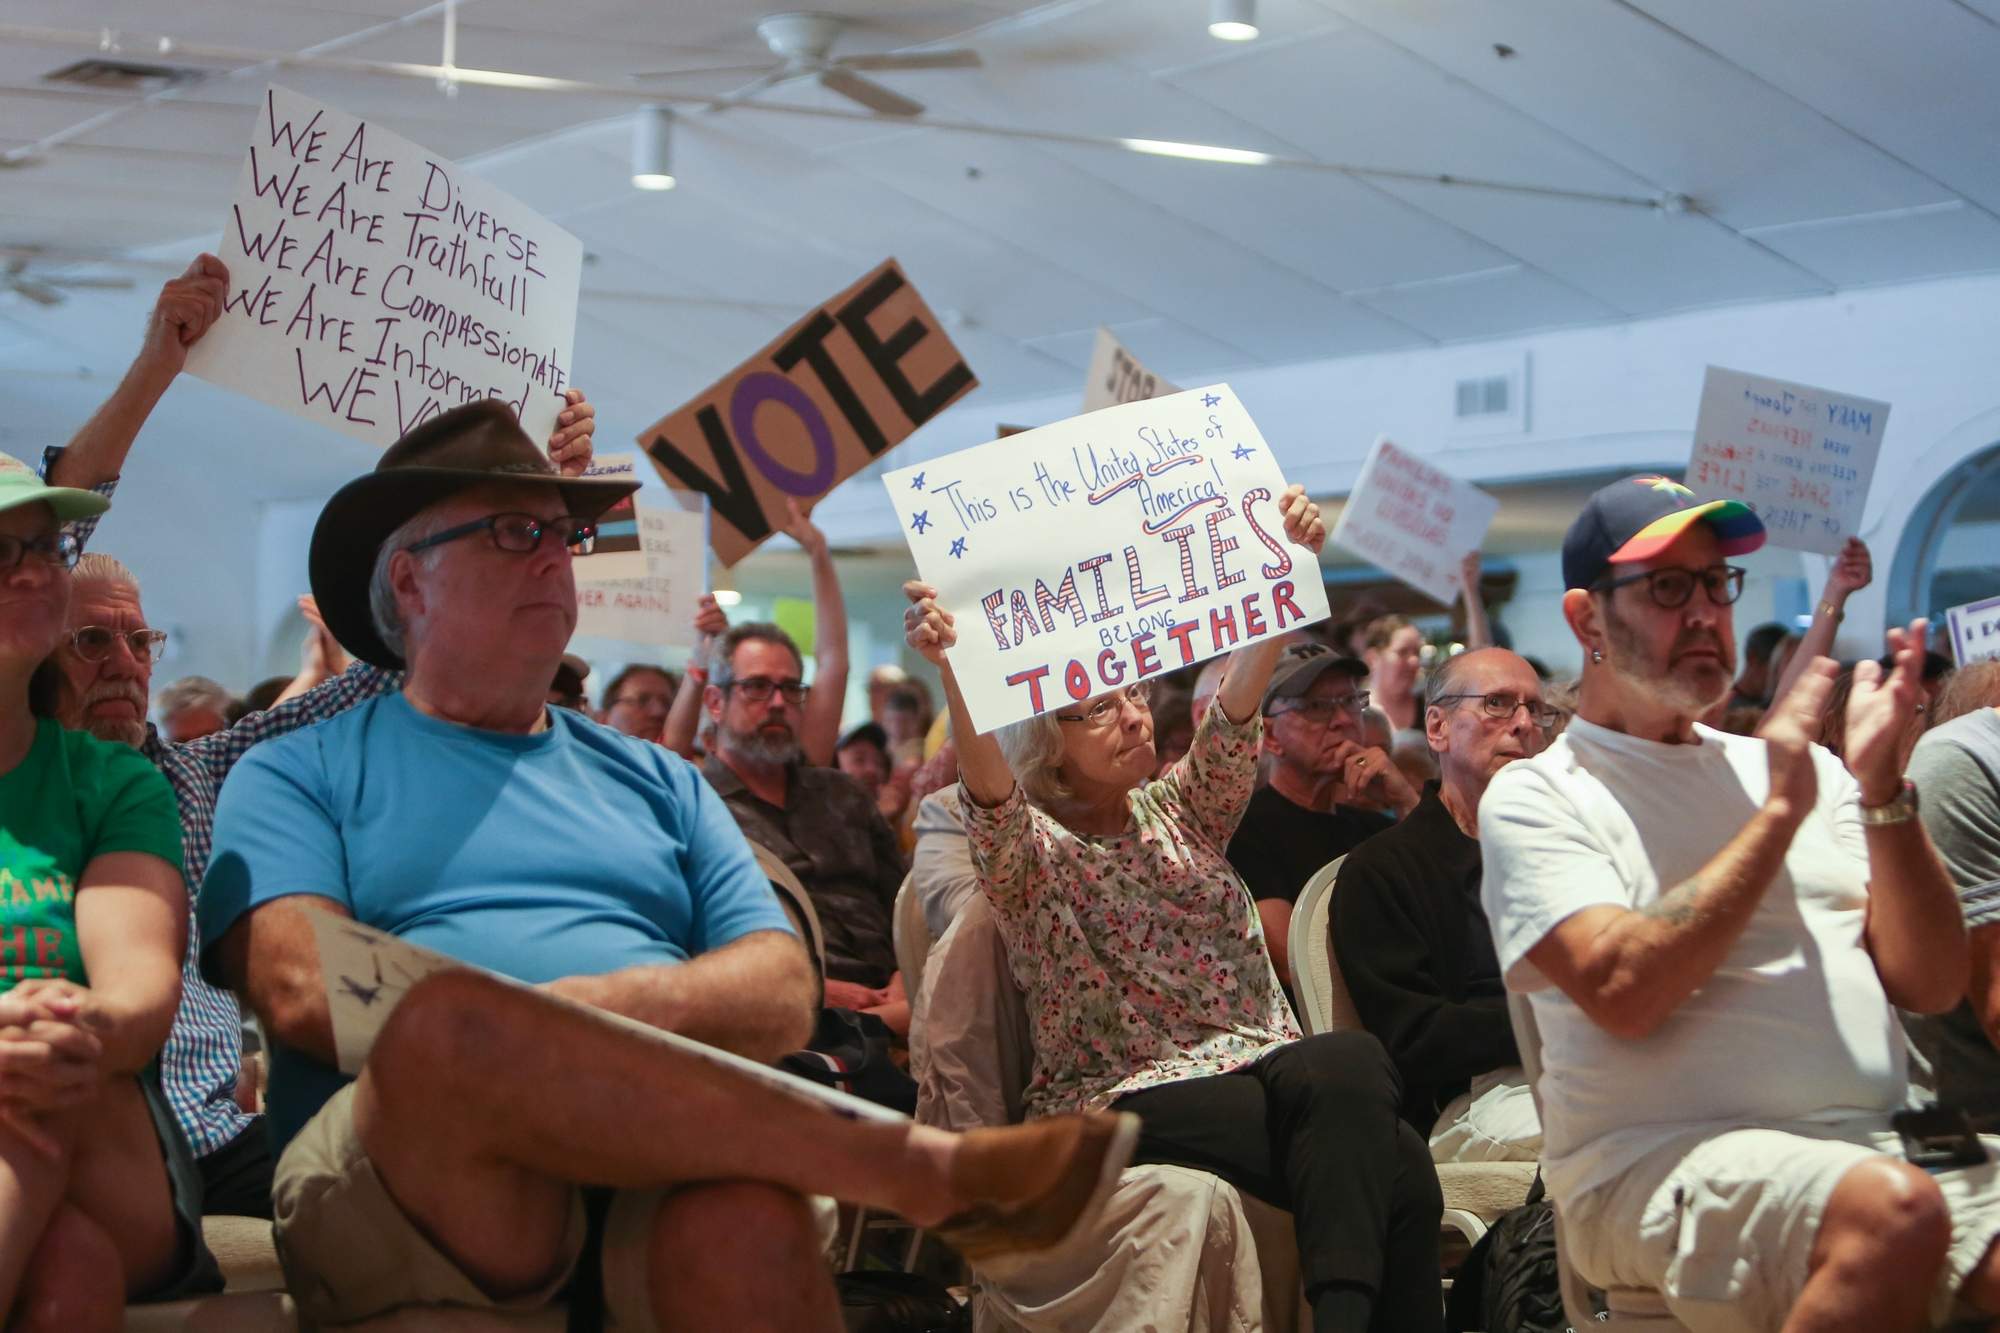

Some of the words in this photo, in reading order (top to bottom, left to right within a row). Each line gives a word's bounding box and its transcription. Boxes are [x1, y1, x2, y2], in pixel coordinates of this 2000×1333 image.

[269, 90, 326, 164] WE
[250, 146, 311, 217] WE
[234, 205, 298, 270] WE
[223, 275, 283, 325] WE
[296, 348, 379, 427] WE
[649, 267, 976, 542] VOTE
[931, 480, 997, 531] This
[1035, 461, 1076, 507] the
[1072, 443, 1141, 492] United
[1138, 425, 1199, 467] States
[1205, 415, 1224, 440] of
[982, 487, 1293, 650] FAMILIES
[1006, 580, 1306, 715] TOGETHER
[1099, 609, 1177, 648] BELONG
